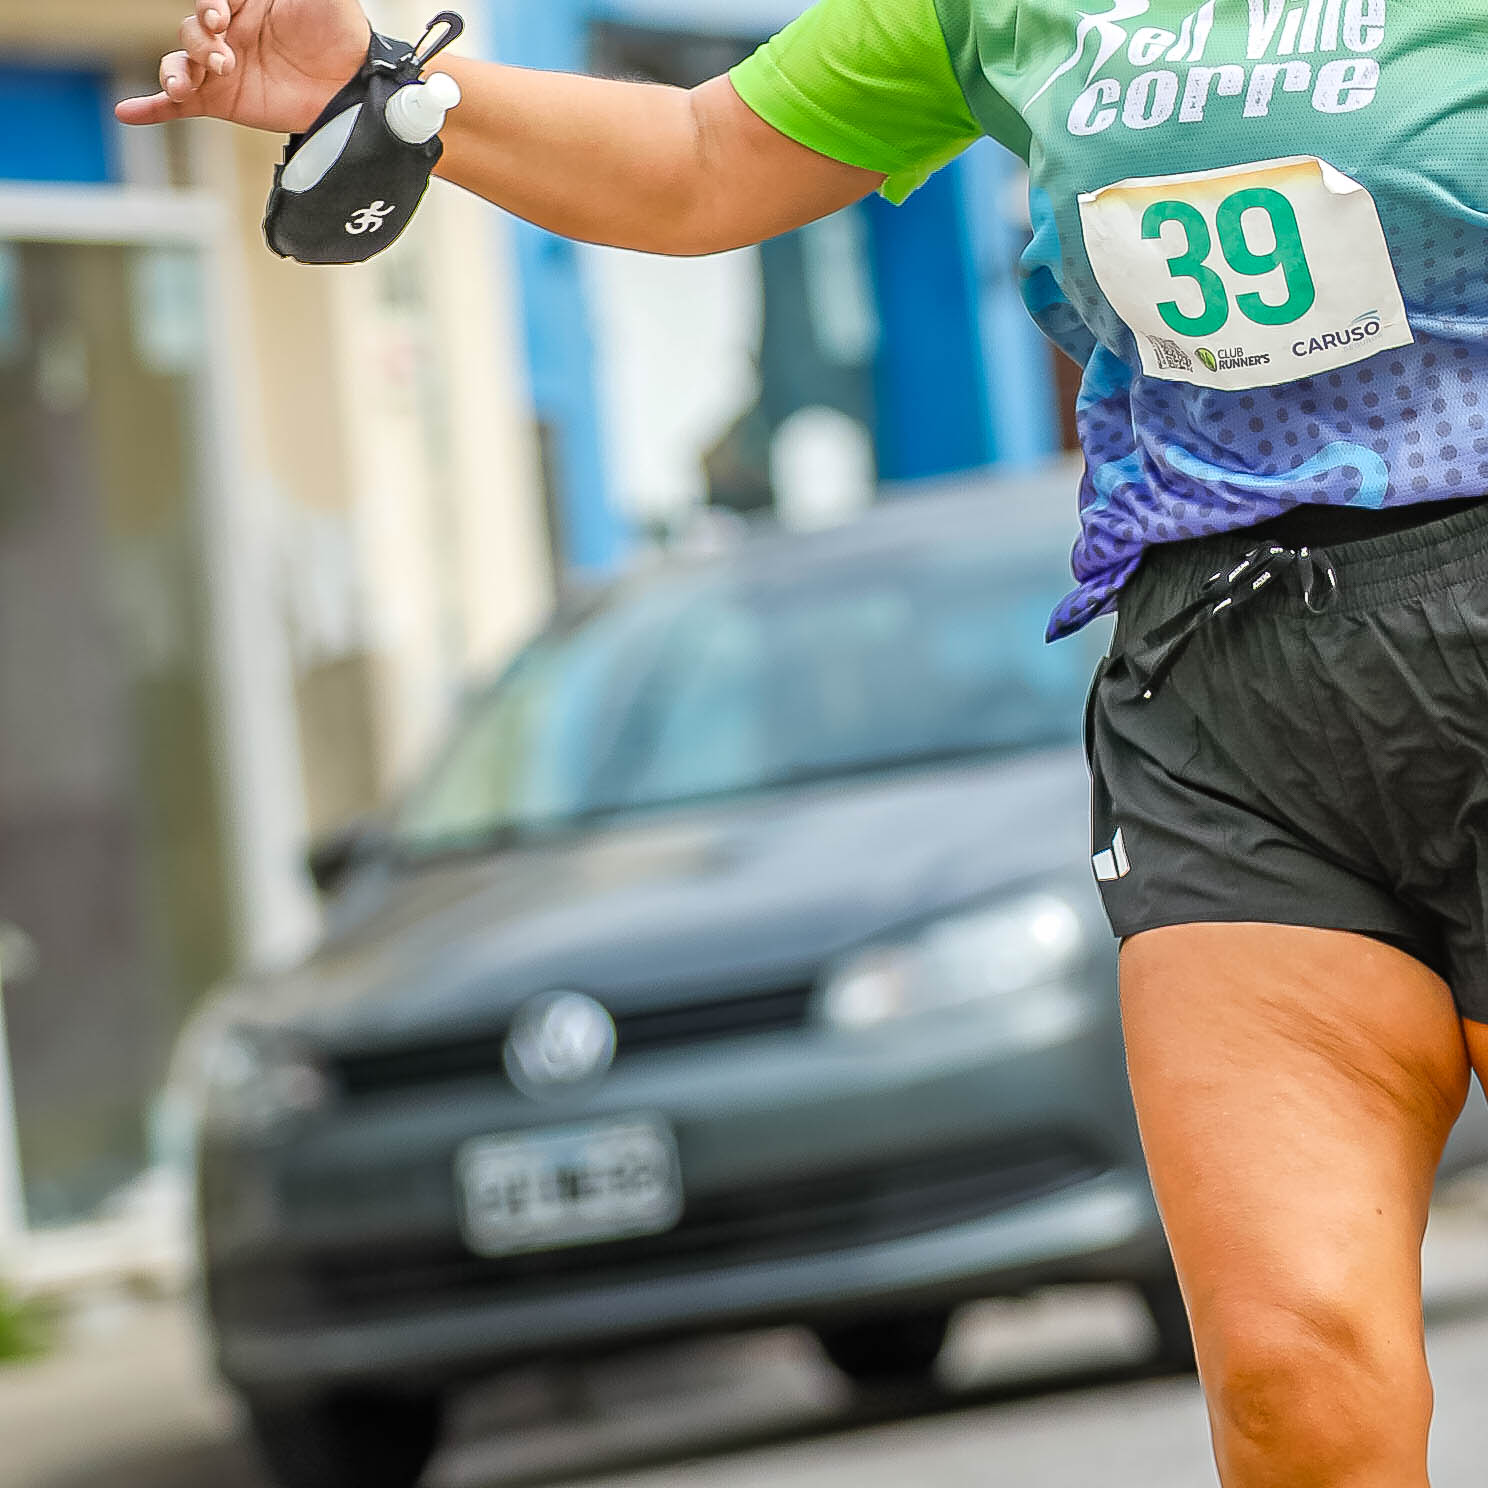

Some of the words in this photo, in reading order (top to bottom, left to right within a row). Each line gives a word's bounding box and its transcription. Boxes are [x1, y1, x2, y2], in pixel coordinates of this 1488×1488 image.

[1066, 57, 1380, 136] corre
[1140, 188, 1316, 337] 39
[1217, 347, 1244, 359] CLUB
[1292, 321, 1380, 357] CARUSO
[1218, 353, 1271, 370] RUNNER'S
